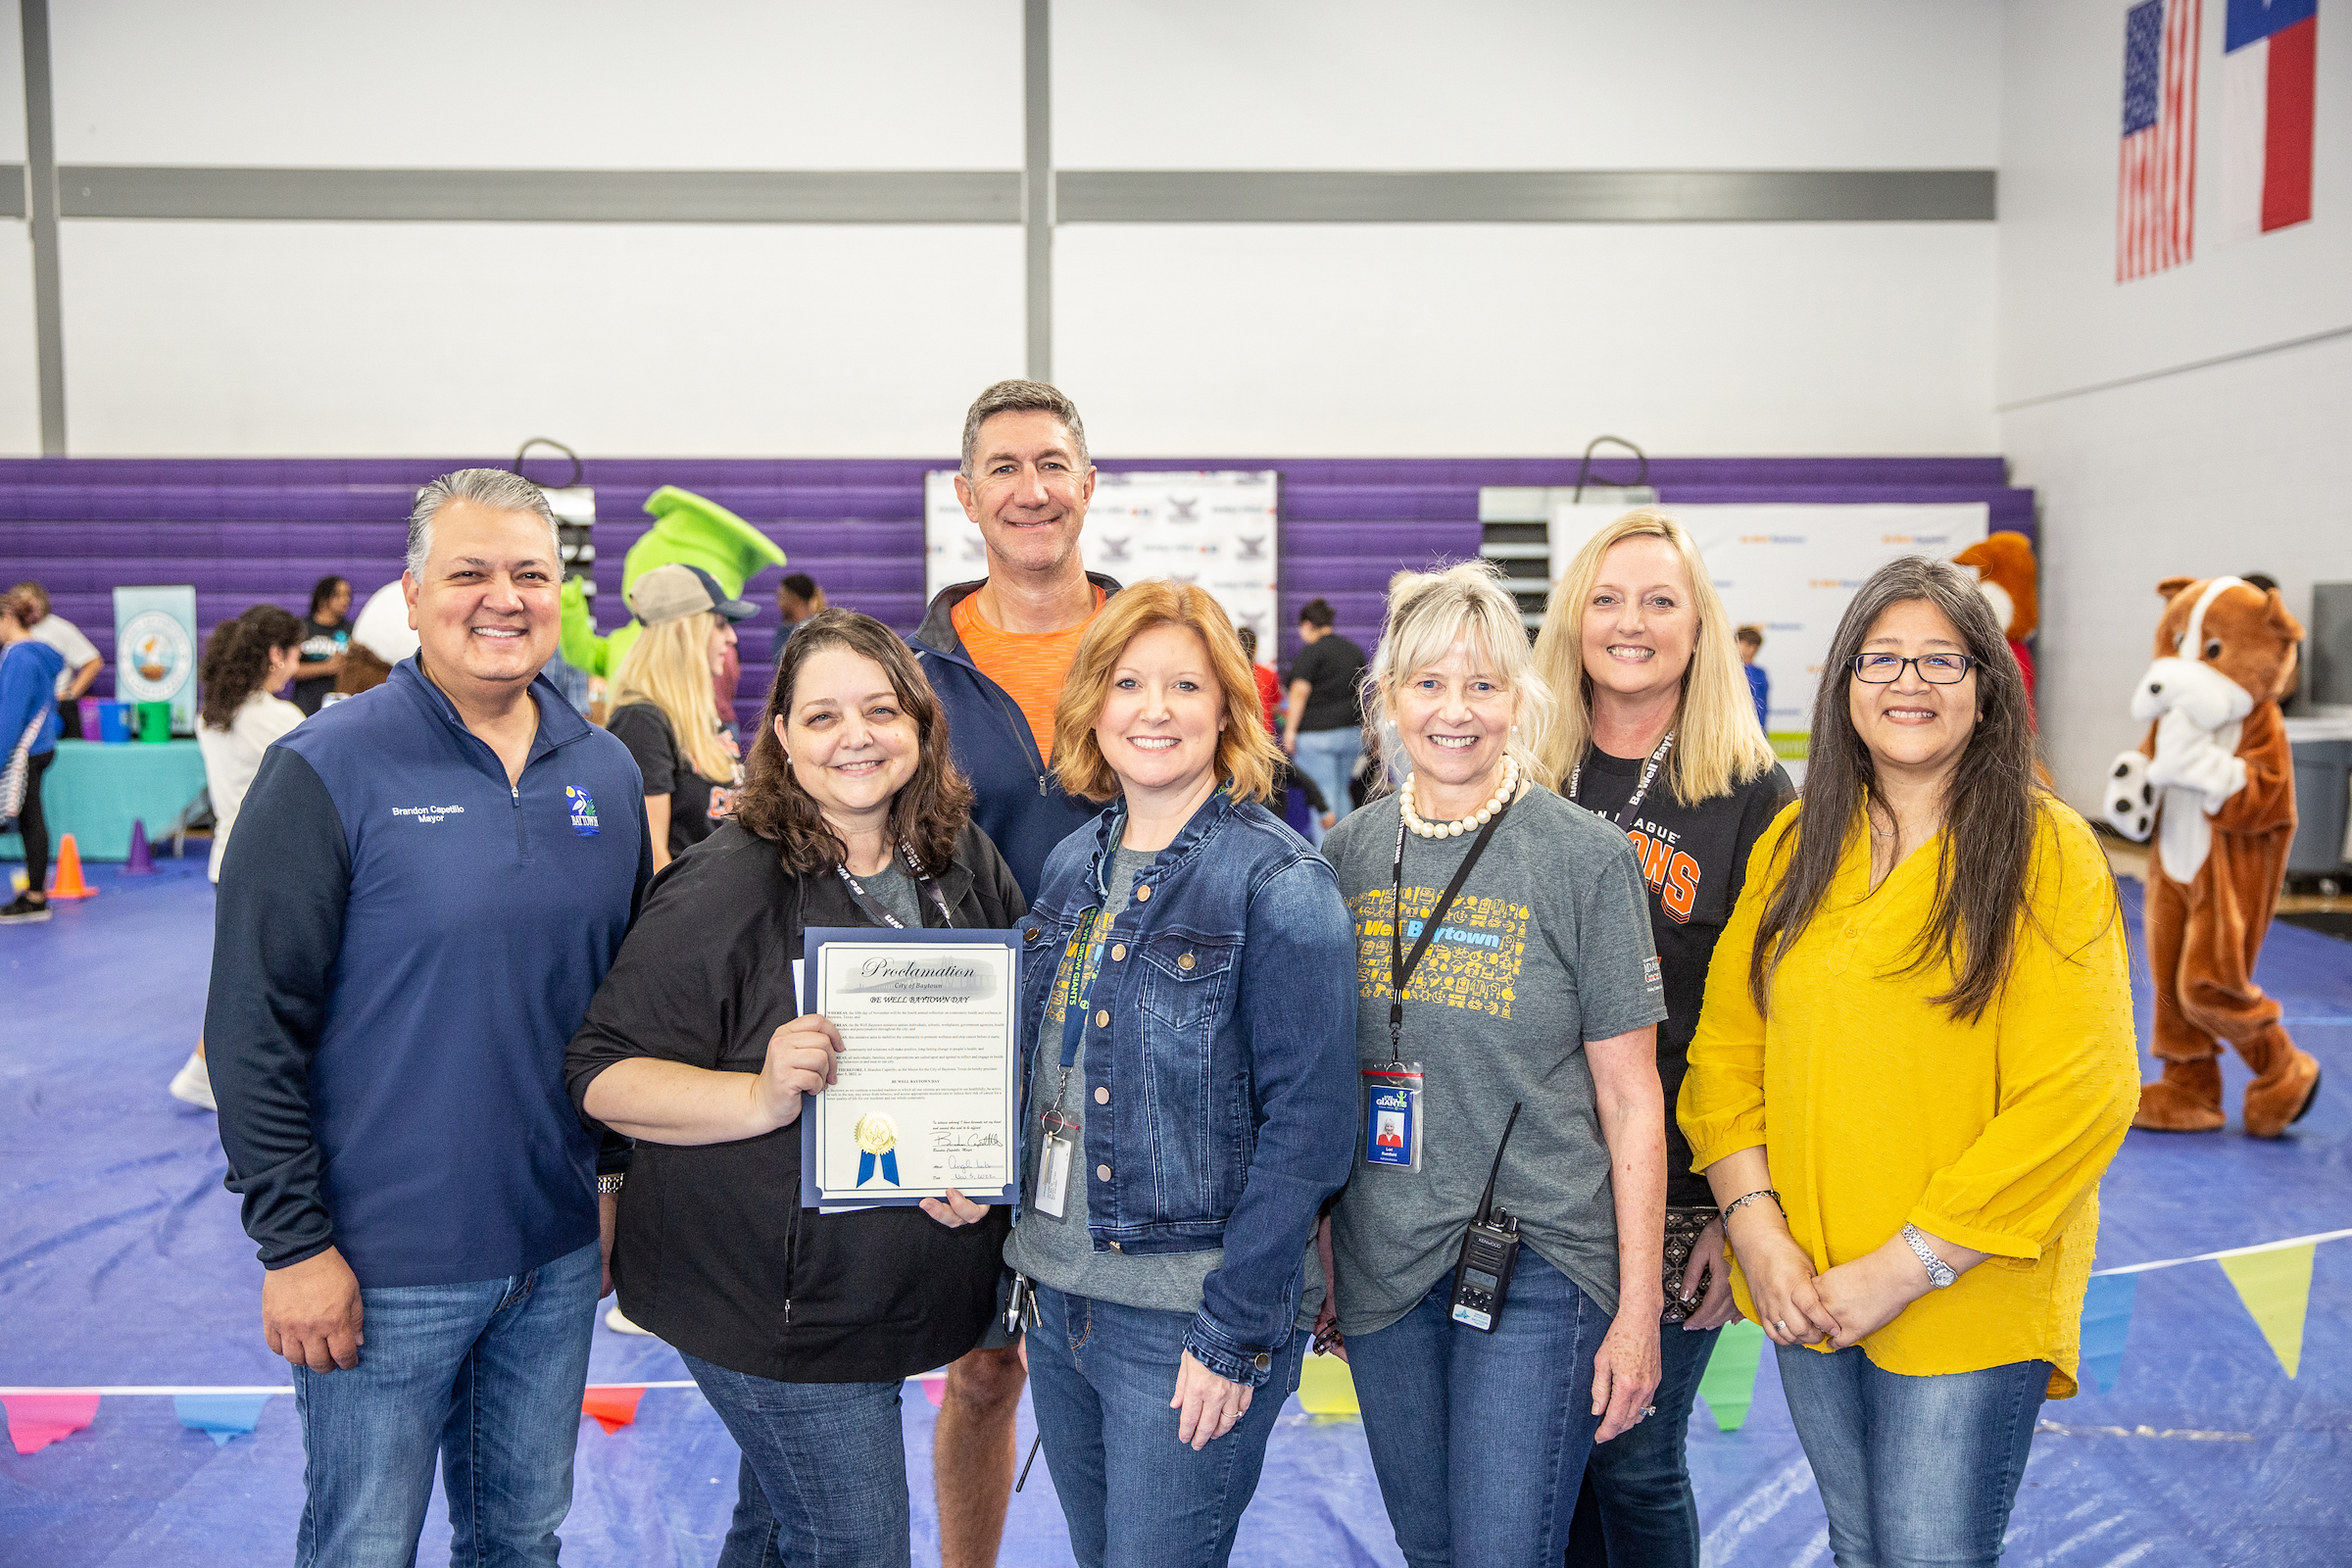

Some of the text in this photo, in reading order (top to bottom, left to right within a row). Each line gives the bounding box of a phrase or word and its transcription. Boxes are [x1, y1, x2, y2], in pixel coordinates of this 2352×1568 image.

[1629, 790, 1643, 806] Be
[1638, 762, 1658, 788] Well
[392, 804, 465, 816] Brandon Capetillo
[418, 813, 445, 824] Mayor
[570, 814, 599, 827] BAYTOWN
[849, 879, 864, 896] Be
[1406, 920, 1499, 949] Bytown
[1075, 943, 1085, 971] GROW
[861, 956, 976, 978] Proclamation
[1069, 972, 1080, 1005] GIANTS
[1376, 1099, 1407, 1107] GIANTS
[1478, 1238, 1501, 1249] KENWOOD
